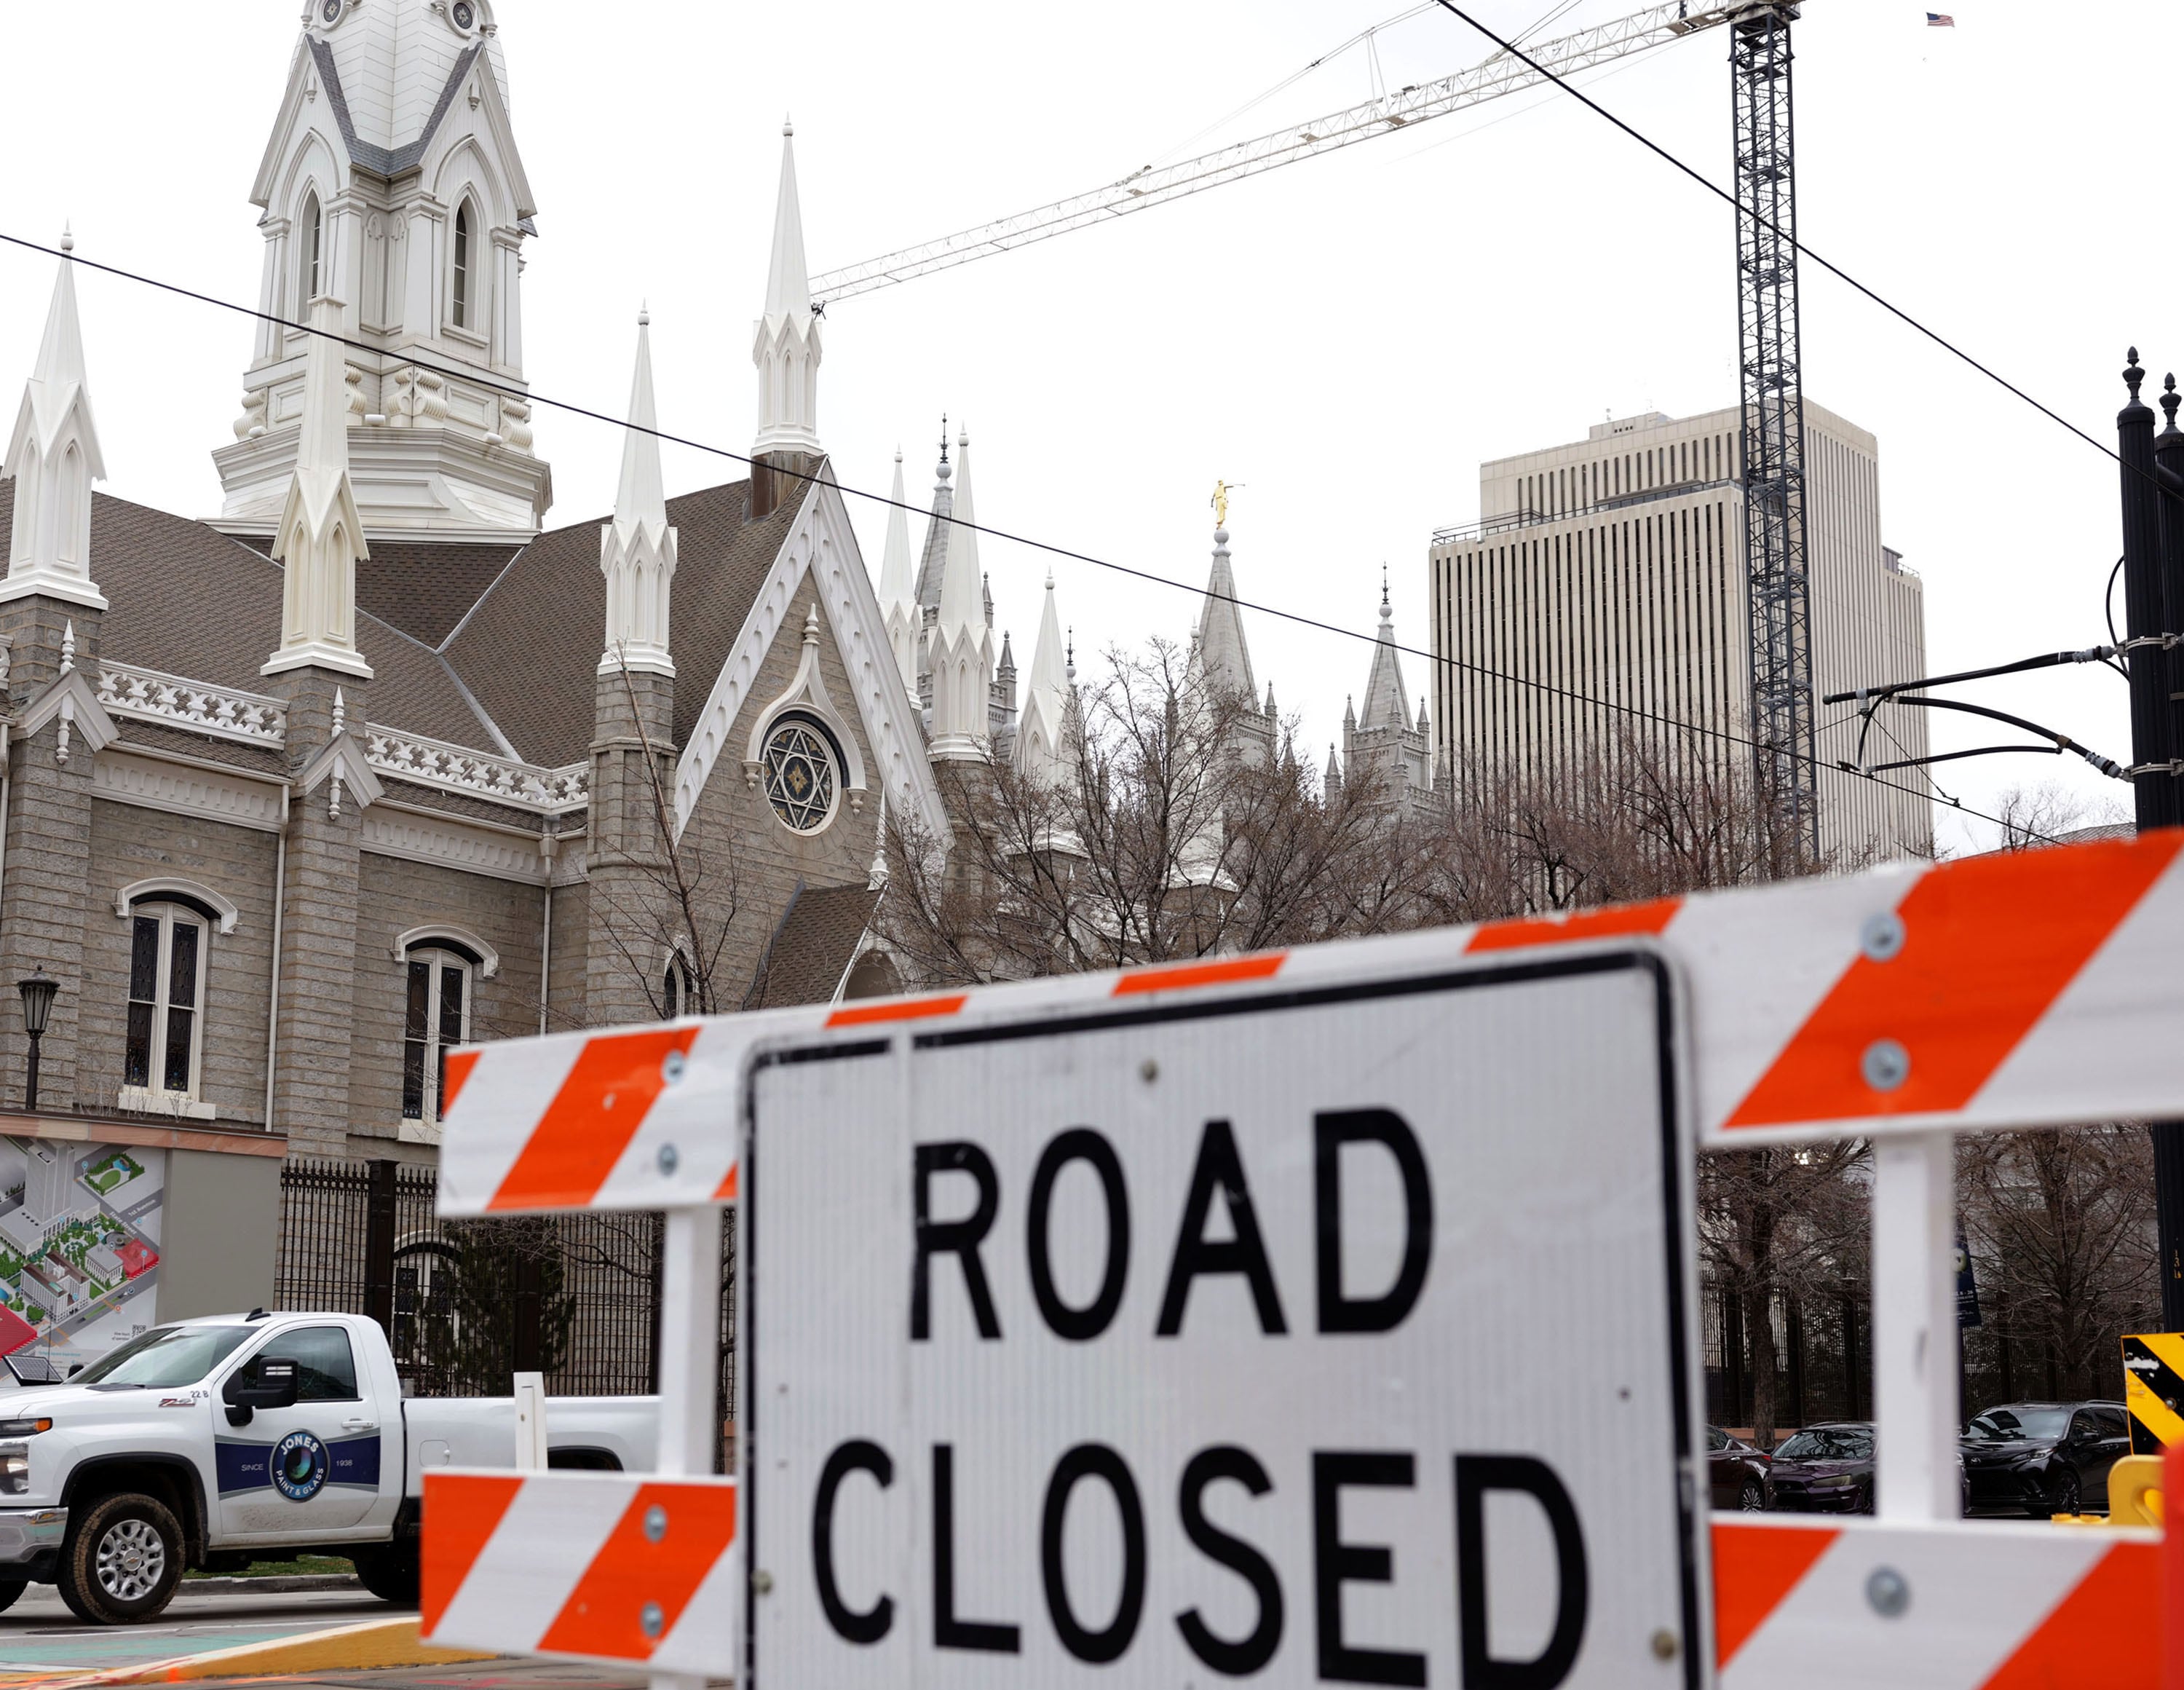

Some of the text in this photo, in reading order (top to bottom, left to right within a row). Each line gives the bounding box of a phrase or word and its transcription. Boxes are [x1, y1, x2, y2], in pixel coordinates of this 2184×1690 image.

[109, 1211, 138, 1235] State Street
[909, 1107, 1434, 1343] ROAD
[190, 1390, 201, 1398] 22
[281, 1435, 319, 1456] JONES
[241, 1464, 264, 1472] SINCE
[276, 1469, 294, 1495] PAINT
[303, 1468, 324, 1495] GLASS
[812, 1439, 1591, 1690] CLOSED
